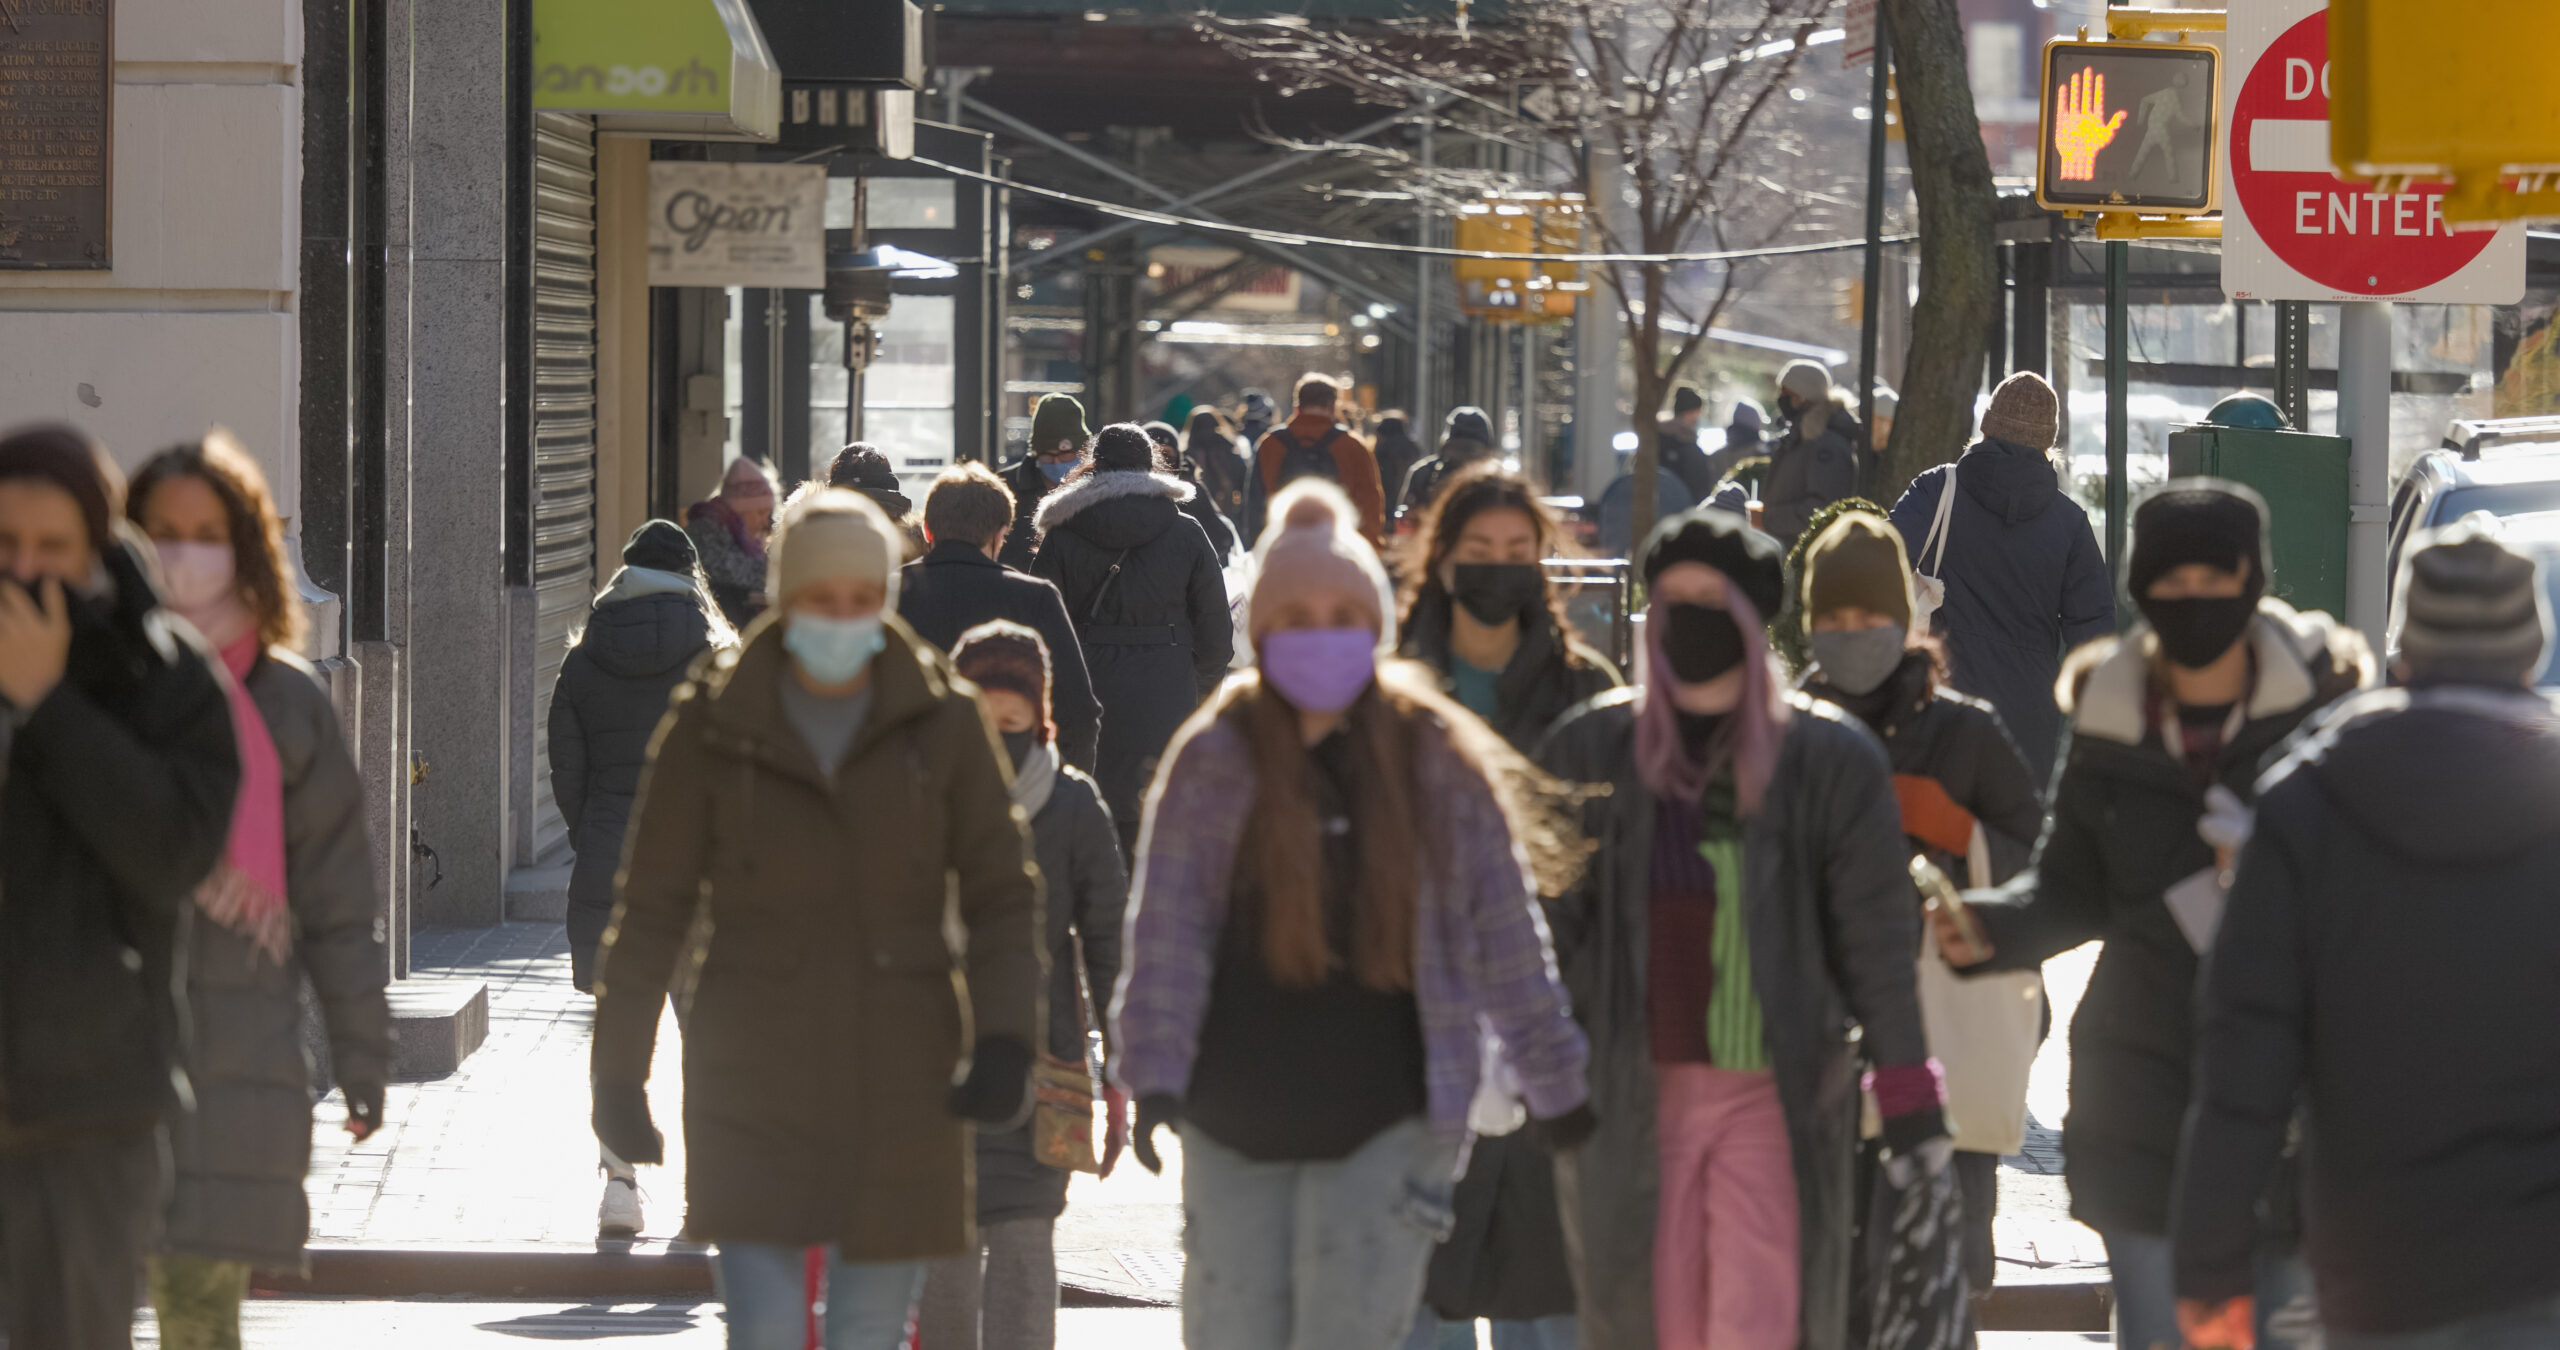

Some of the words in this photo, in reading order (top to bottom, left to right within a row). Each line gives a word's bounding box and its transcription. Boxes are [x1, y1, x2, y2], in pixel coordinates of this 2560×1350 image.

[44, 55, 100, 66] MARCHED
[9, 143, 37, 156] BULL
[8, 159, 98, 171] FREDERICKSBURG
[2296, 191, 2454, 237] ENTER
[665, 189, 793, 254] Open
